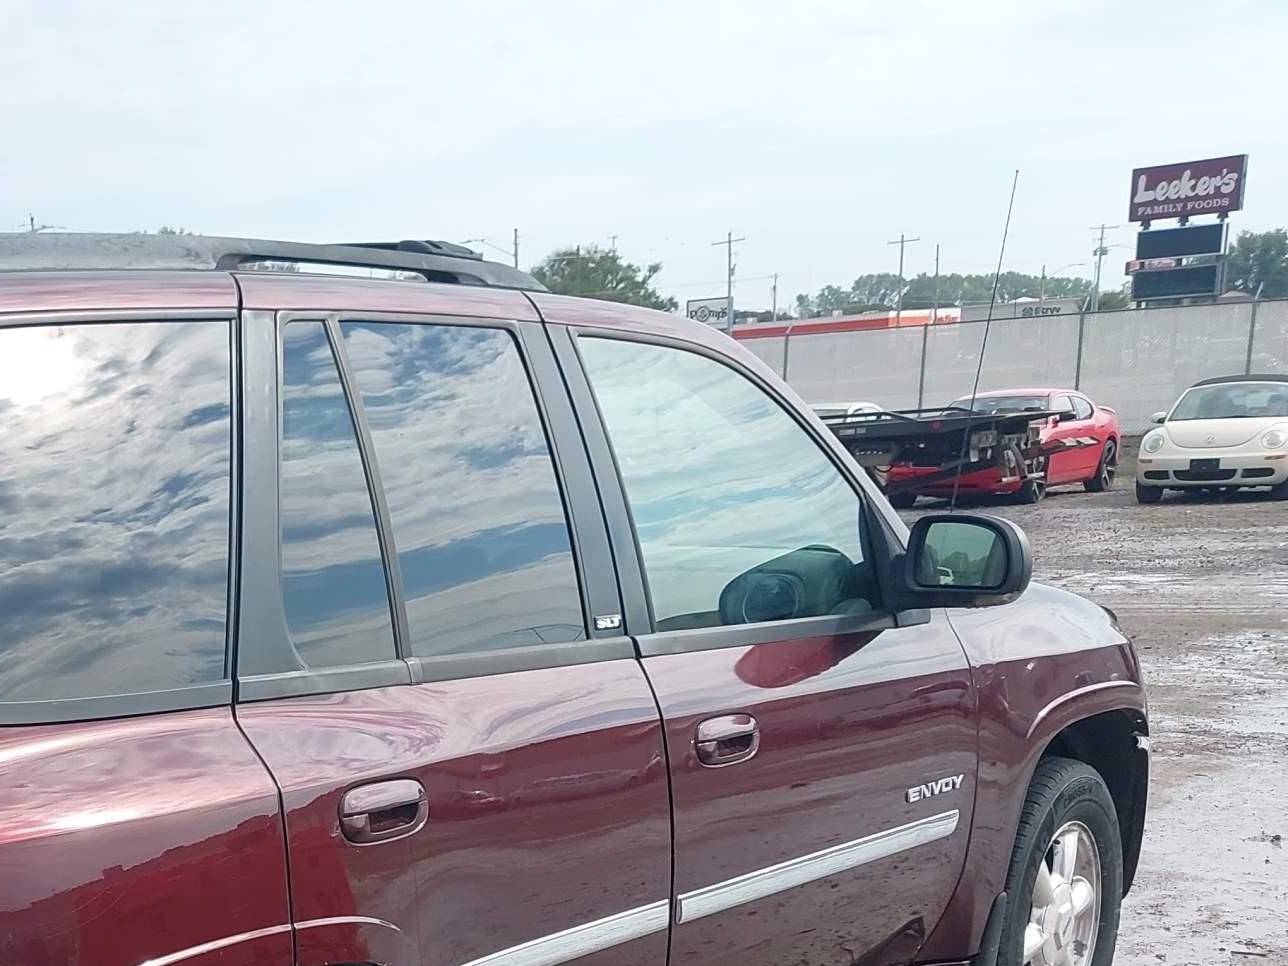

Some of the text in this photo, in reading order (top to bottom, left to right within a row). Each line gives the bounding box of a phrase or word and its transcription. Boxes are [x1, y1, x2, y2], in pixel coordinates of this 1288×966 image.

[1133, 168, 1239, 203] Leeker's
[1137, 197, 1229, 215] FAMILY FOODS
[907, 774, 964, 802] ENVOY
